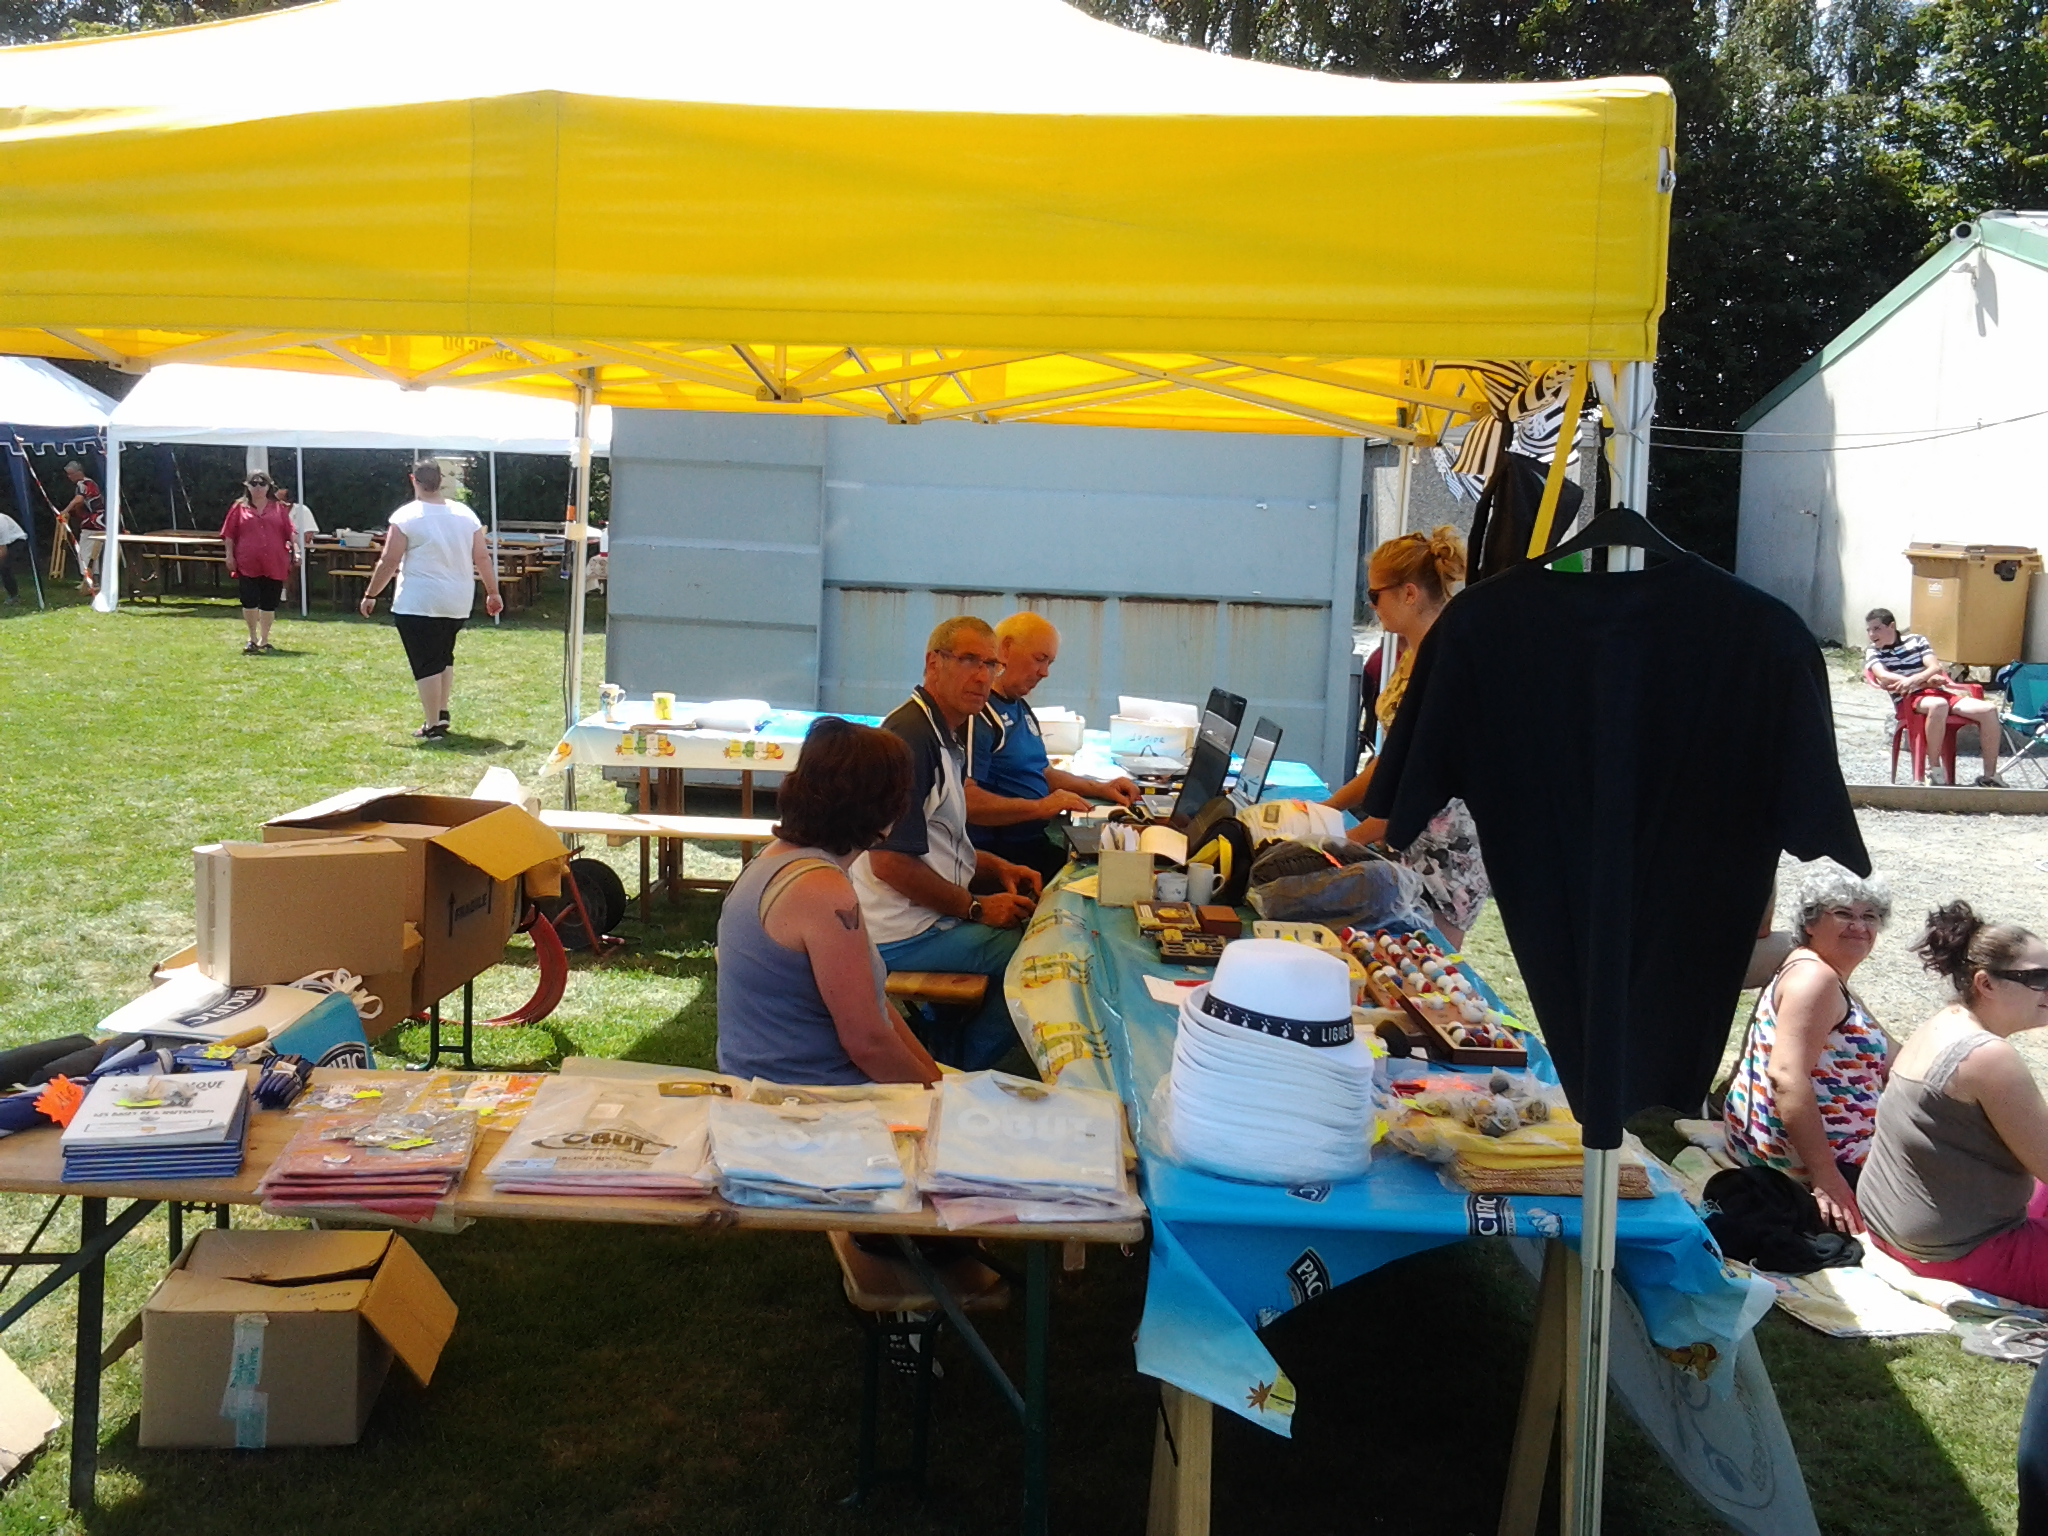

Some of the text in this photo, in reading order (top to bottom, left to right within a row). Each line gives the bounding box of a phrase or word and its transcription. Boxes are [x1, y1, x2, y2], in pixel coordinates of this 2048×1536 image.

[184, 988, 257, 1027] PACIFIC
[1321, 1025, 1348, 1042] LIGUE
[956, 1106, 1092, 1143] OBUT
[562, 1131, 645, 1155] OBUT
